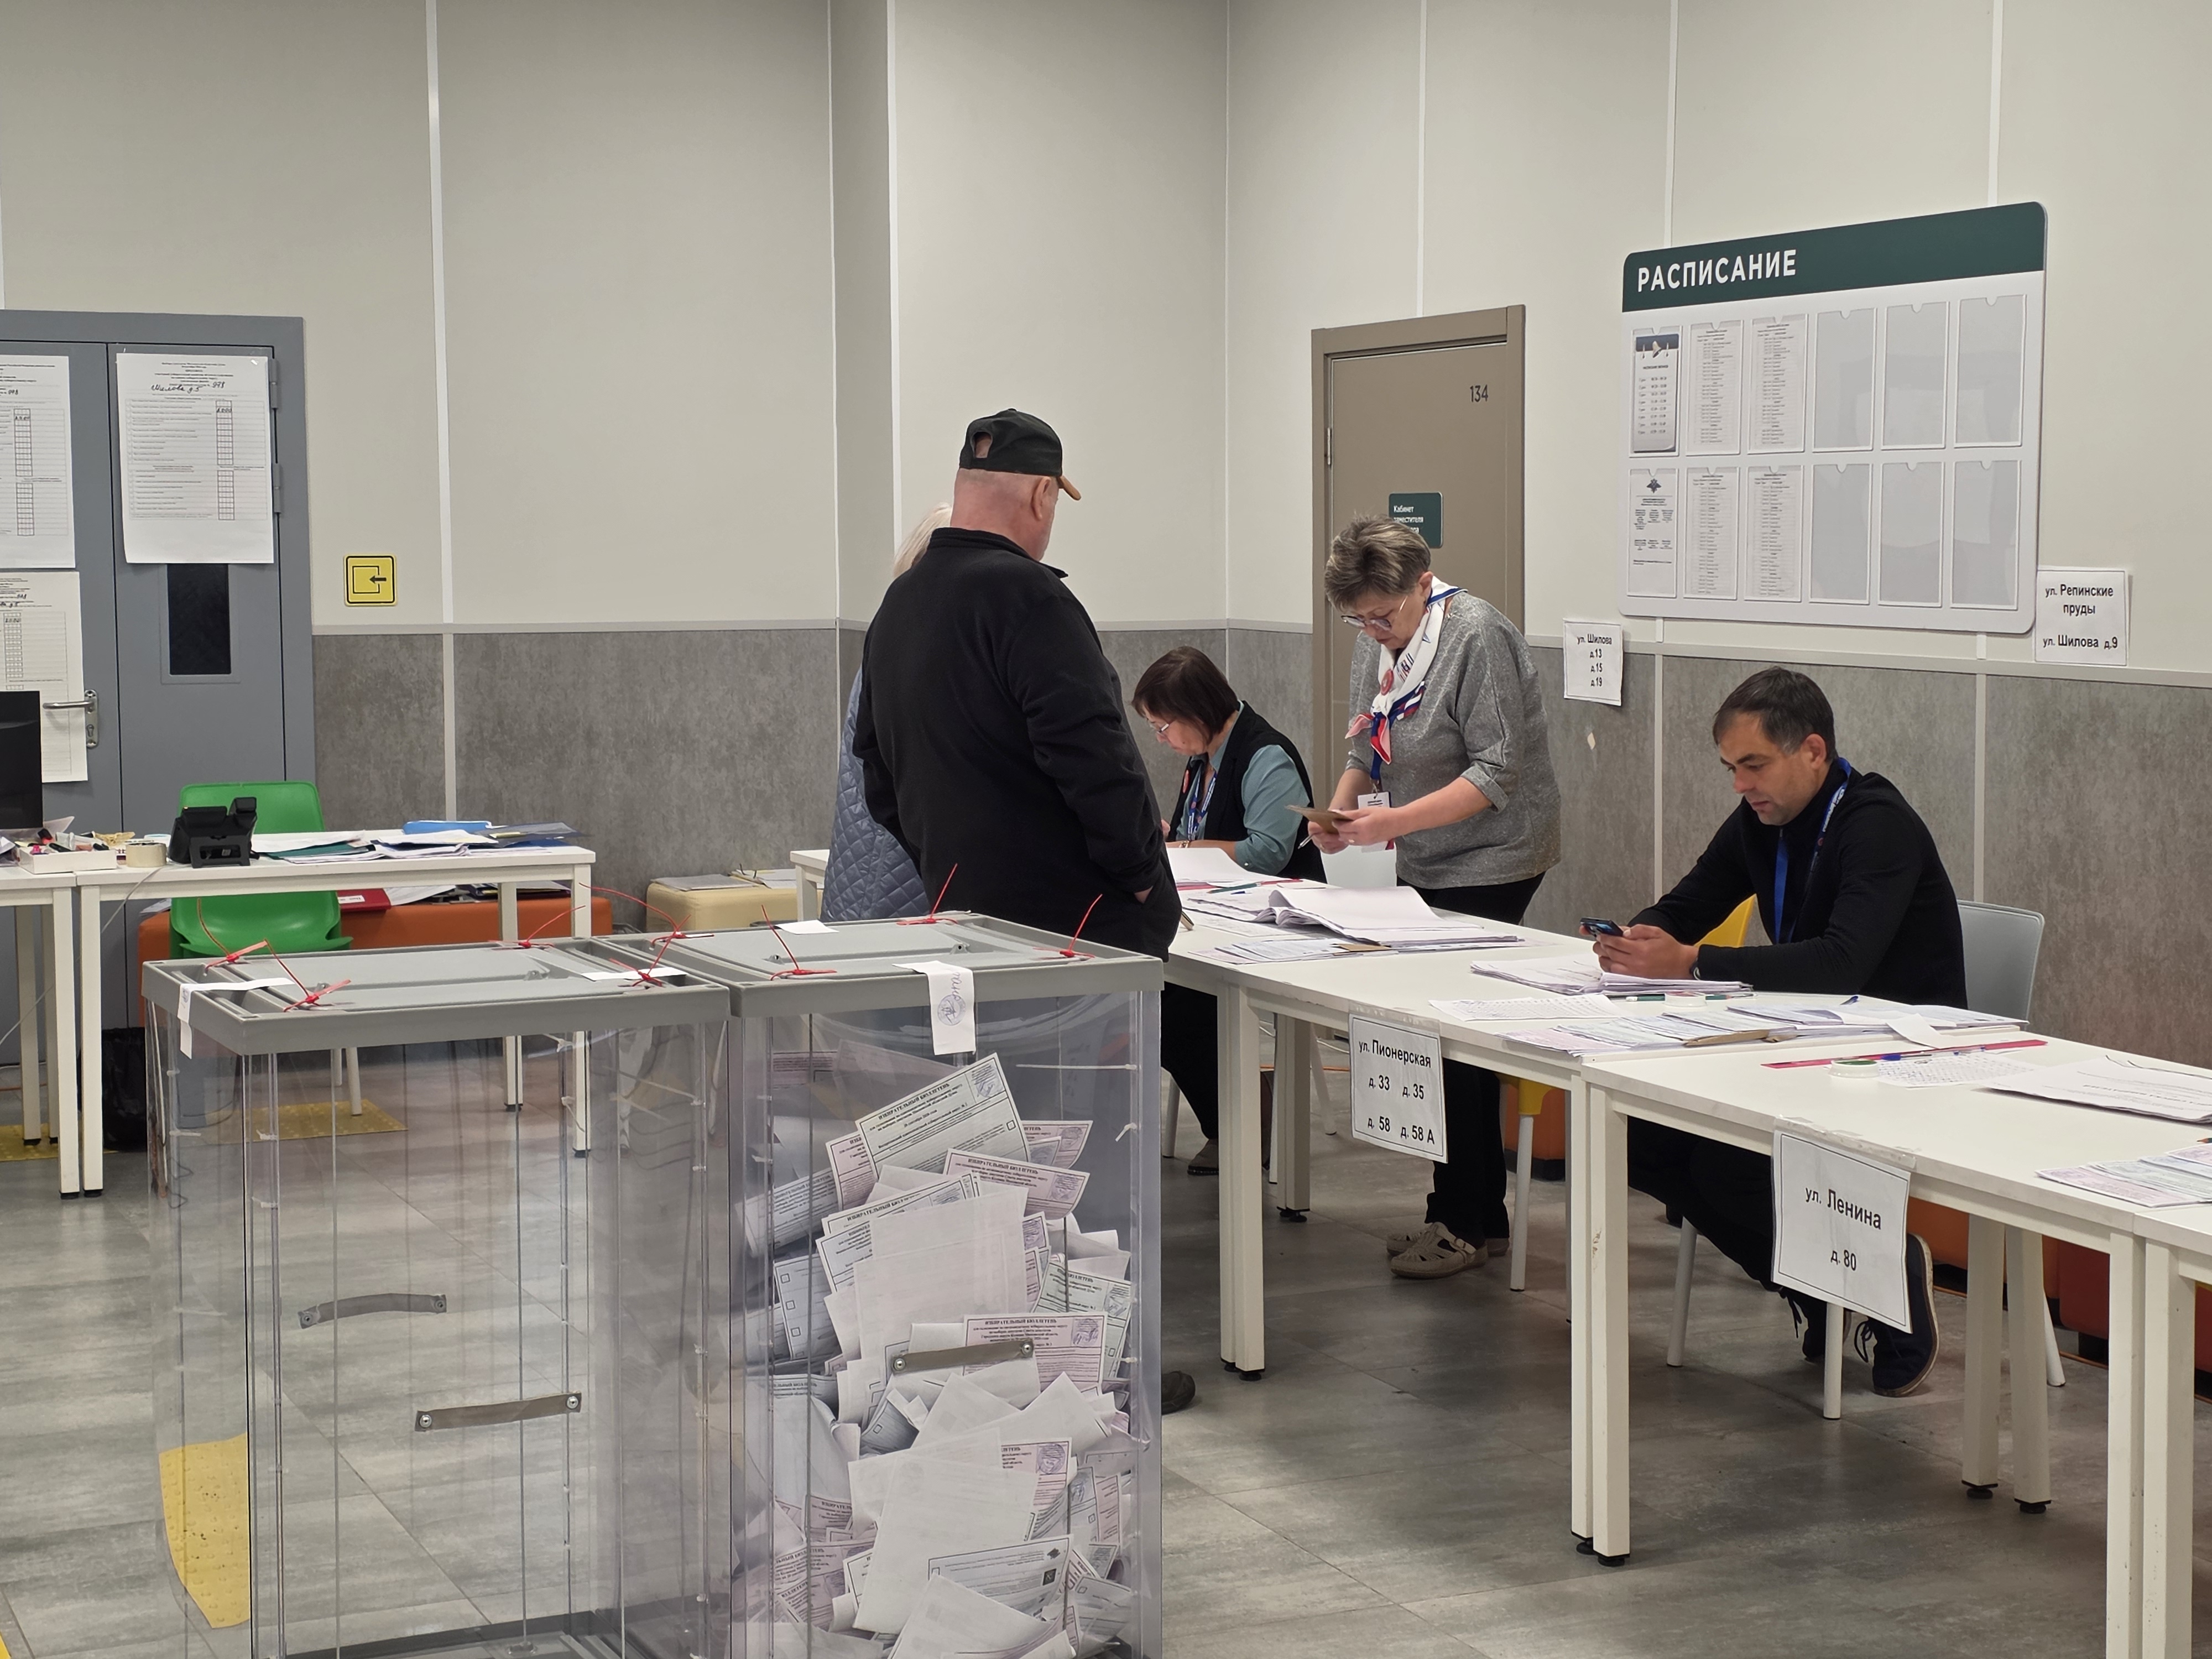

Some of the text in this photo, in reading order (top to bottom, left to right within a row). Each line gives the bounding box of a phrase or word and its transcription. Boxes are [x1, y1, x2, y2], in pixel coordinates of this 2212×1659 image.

[1638, 249, 1796, 292] РАСПИСАНИЕ
[1470, 384, 1488, 403] 134
[2045, 584, 2114, 598] ул. Репинские
[2063, 604, 2096, 617] пруды
[1577, 634, 1613, 645] ул. Шилова
[2043, 638, 2056, 648] ул.
[2058, 635, 2099, 648] Шилова
[1359, 1039, 1431, 1068] ул. Пионерская
[1369, 1075, 1390, 1091] д. 33
[1402, 1083, 1424, 1100] д. 35
[1368, 1116, 1390, 1132] д. 58
[1400, 1126, 1409, 1139] д.
[1412, 1125, 1423, 1141] 58
[1805, 1187, 1881, 1230] ул. Ленина
[1830, 1249, 1856, 1271] д. 80
